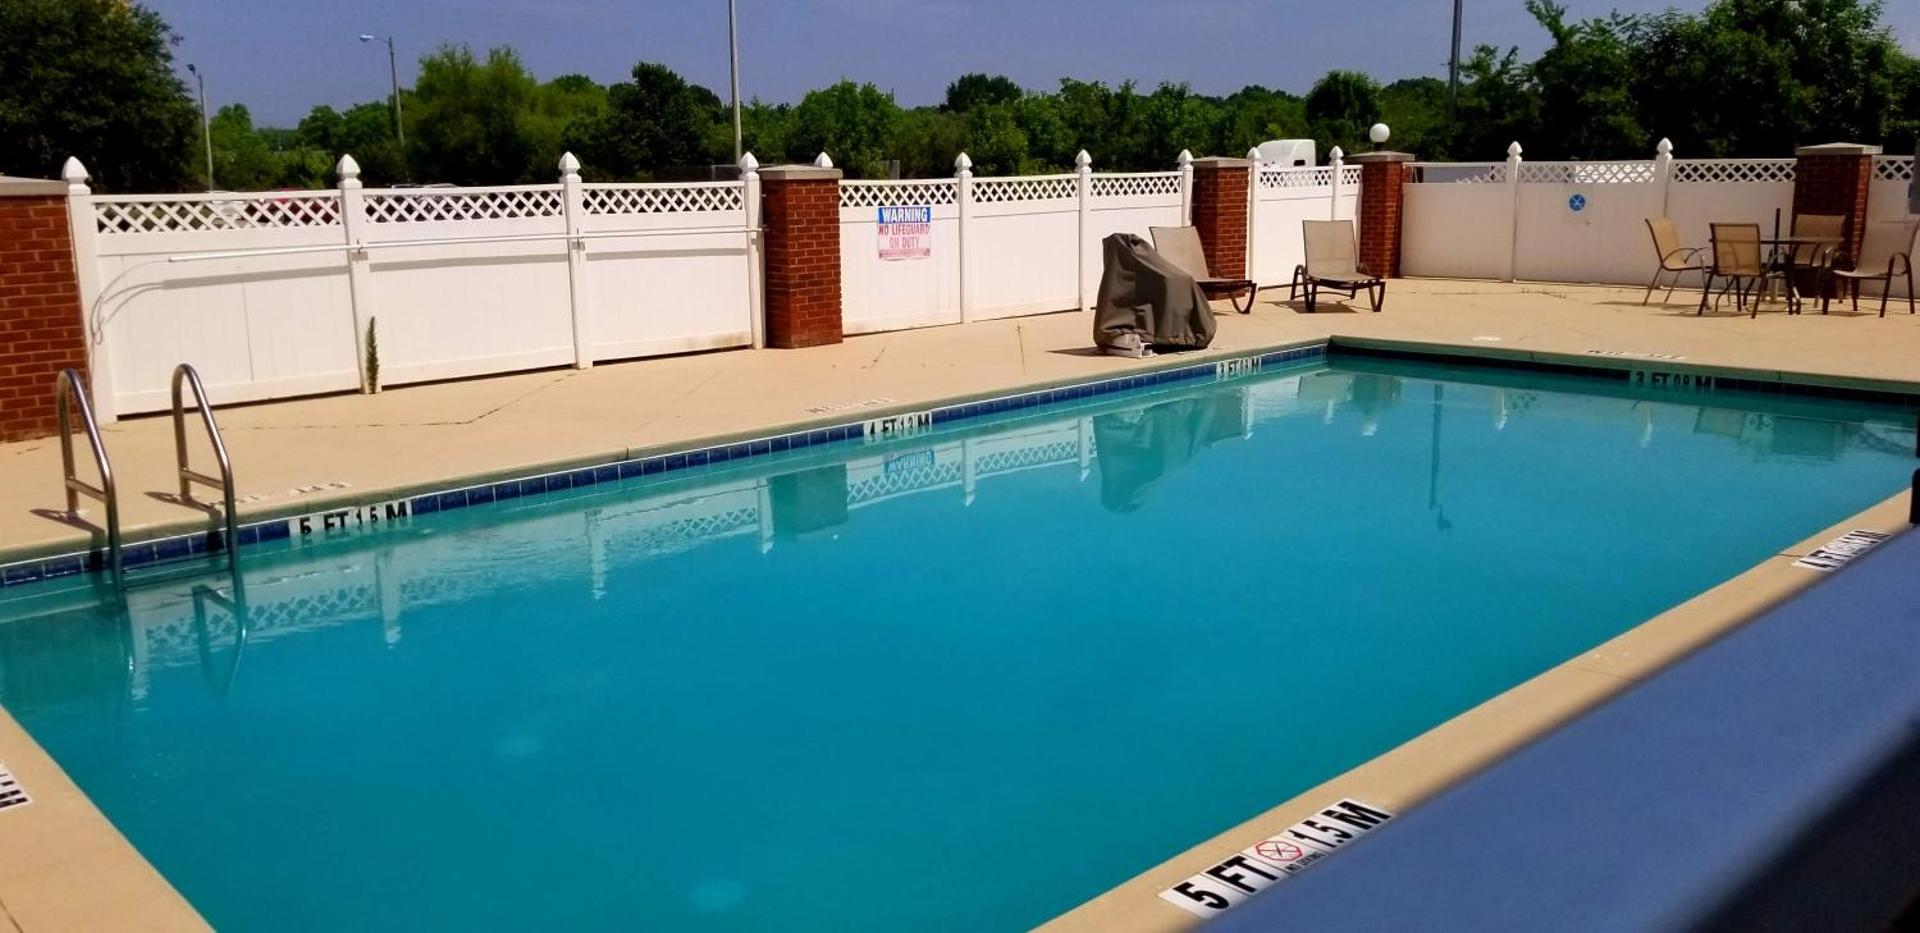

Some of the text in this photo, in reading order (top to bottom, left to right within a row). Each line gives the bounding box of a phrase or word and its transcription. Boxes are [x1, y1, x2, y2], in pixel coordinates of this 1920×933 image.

[882, 207, 928, 222] WARNING
[878, 223, 930, 235] NO LIFEGUARD
[889, 236, 919, 249] ON DUTY
[1652, 372, 1670, 385] FT
[1695, 375, 1713, 388] M
[868, 421, 876, 435] 4
[882, 418, 897, 433] FT
[917, 412, 930, 427] M
[299, 516, 313, 535] 5
[323, 511, 349, 530] FT
[385, 500, 408, 519] M
[1808, 549, 1852, 563] FT
[1172, 800, 1393, 910] 5 FT 1.5 M
